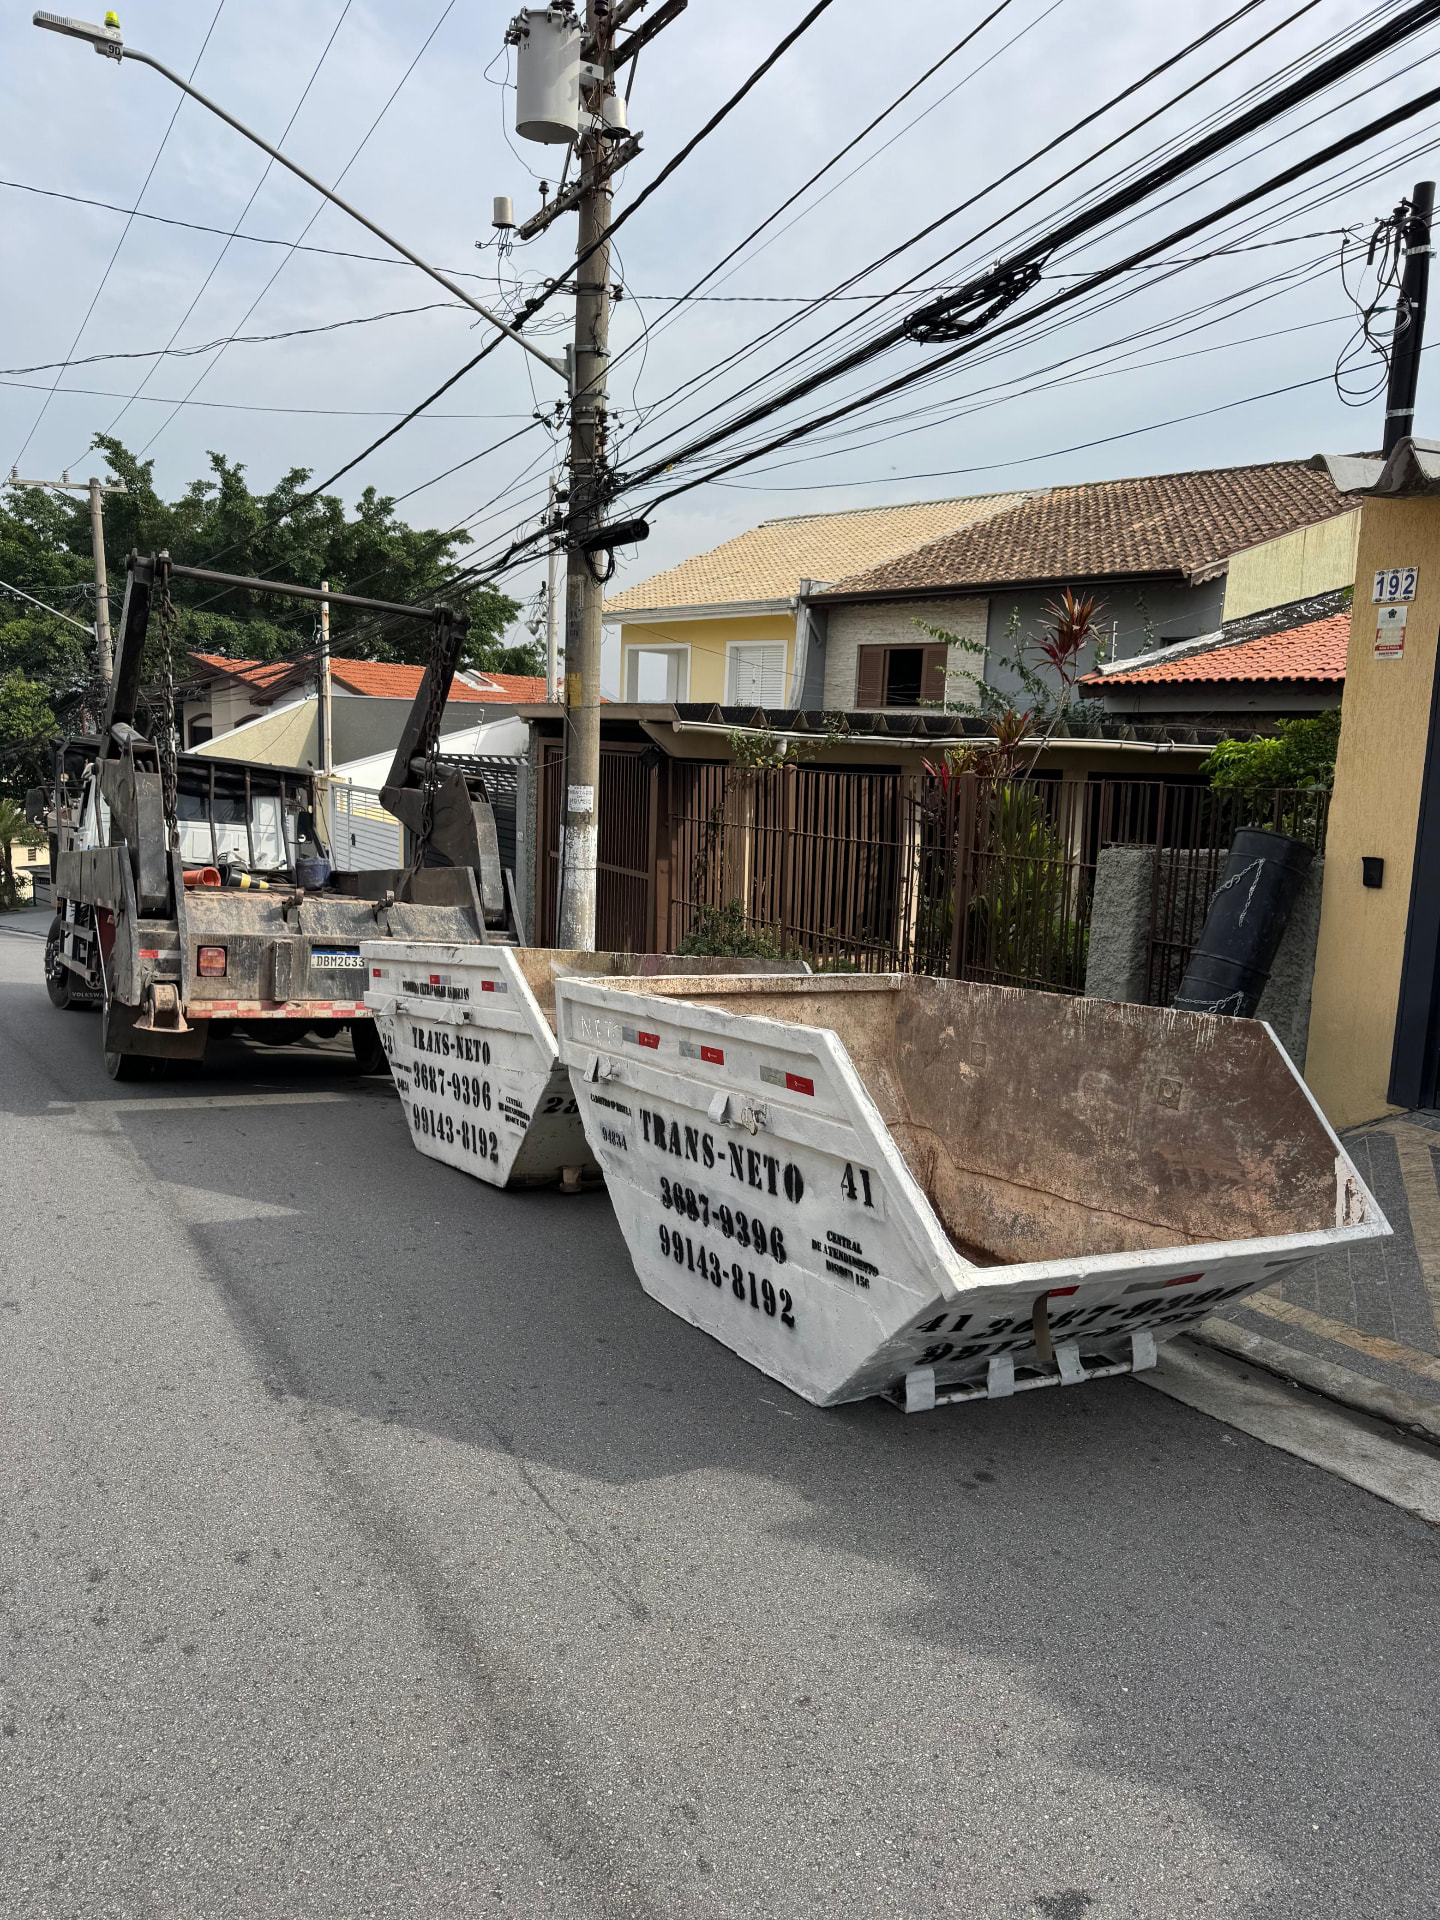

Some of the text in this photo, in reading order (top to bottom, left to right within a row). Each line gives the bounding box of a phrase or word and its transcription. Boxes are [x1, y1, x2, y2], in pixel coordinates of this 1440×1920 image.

[108, 44, 121, 56] 90
[1376, 573, 1415, 597] 192
[412, 1026, 491, 1066] TRANS-NETO
[413, 1061, 491, 1111] 3687-9396
[413, 1103, 498, 1163] 99143-8192
[639, 1108, 804, 1204] TRANS-NETO
[841, 1163, 874, 1209] 41
[659, 1176, 788, 1265] 3687-9396
[811, 1238, 823, 1252] DE
[827, 1230, 863, 1255] CENTRAL
[659, 1224, 796, 1329] 99143-8192
[855, 1273, 871, 1290] 156
[915, 1312, 974, 1333] 41
